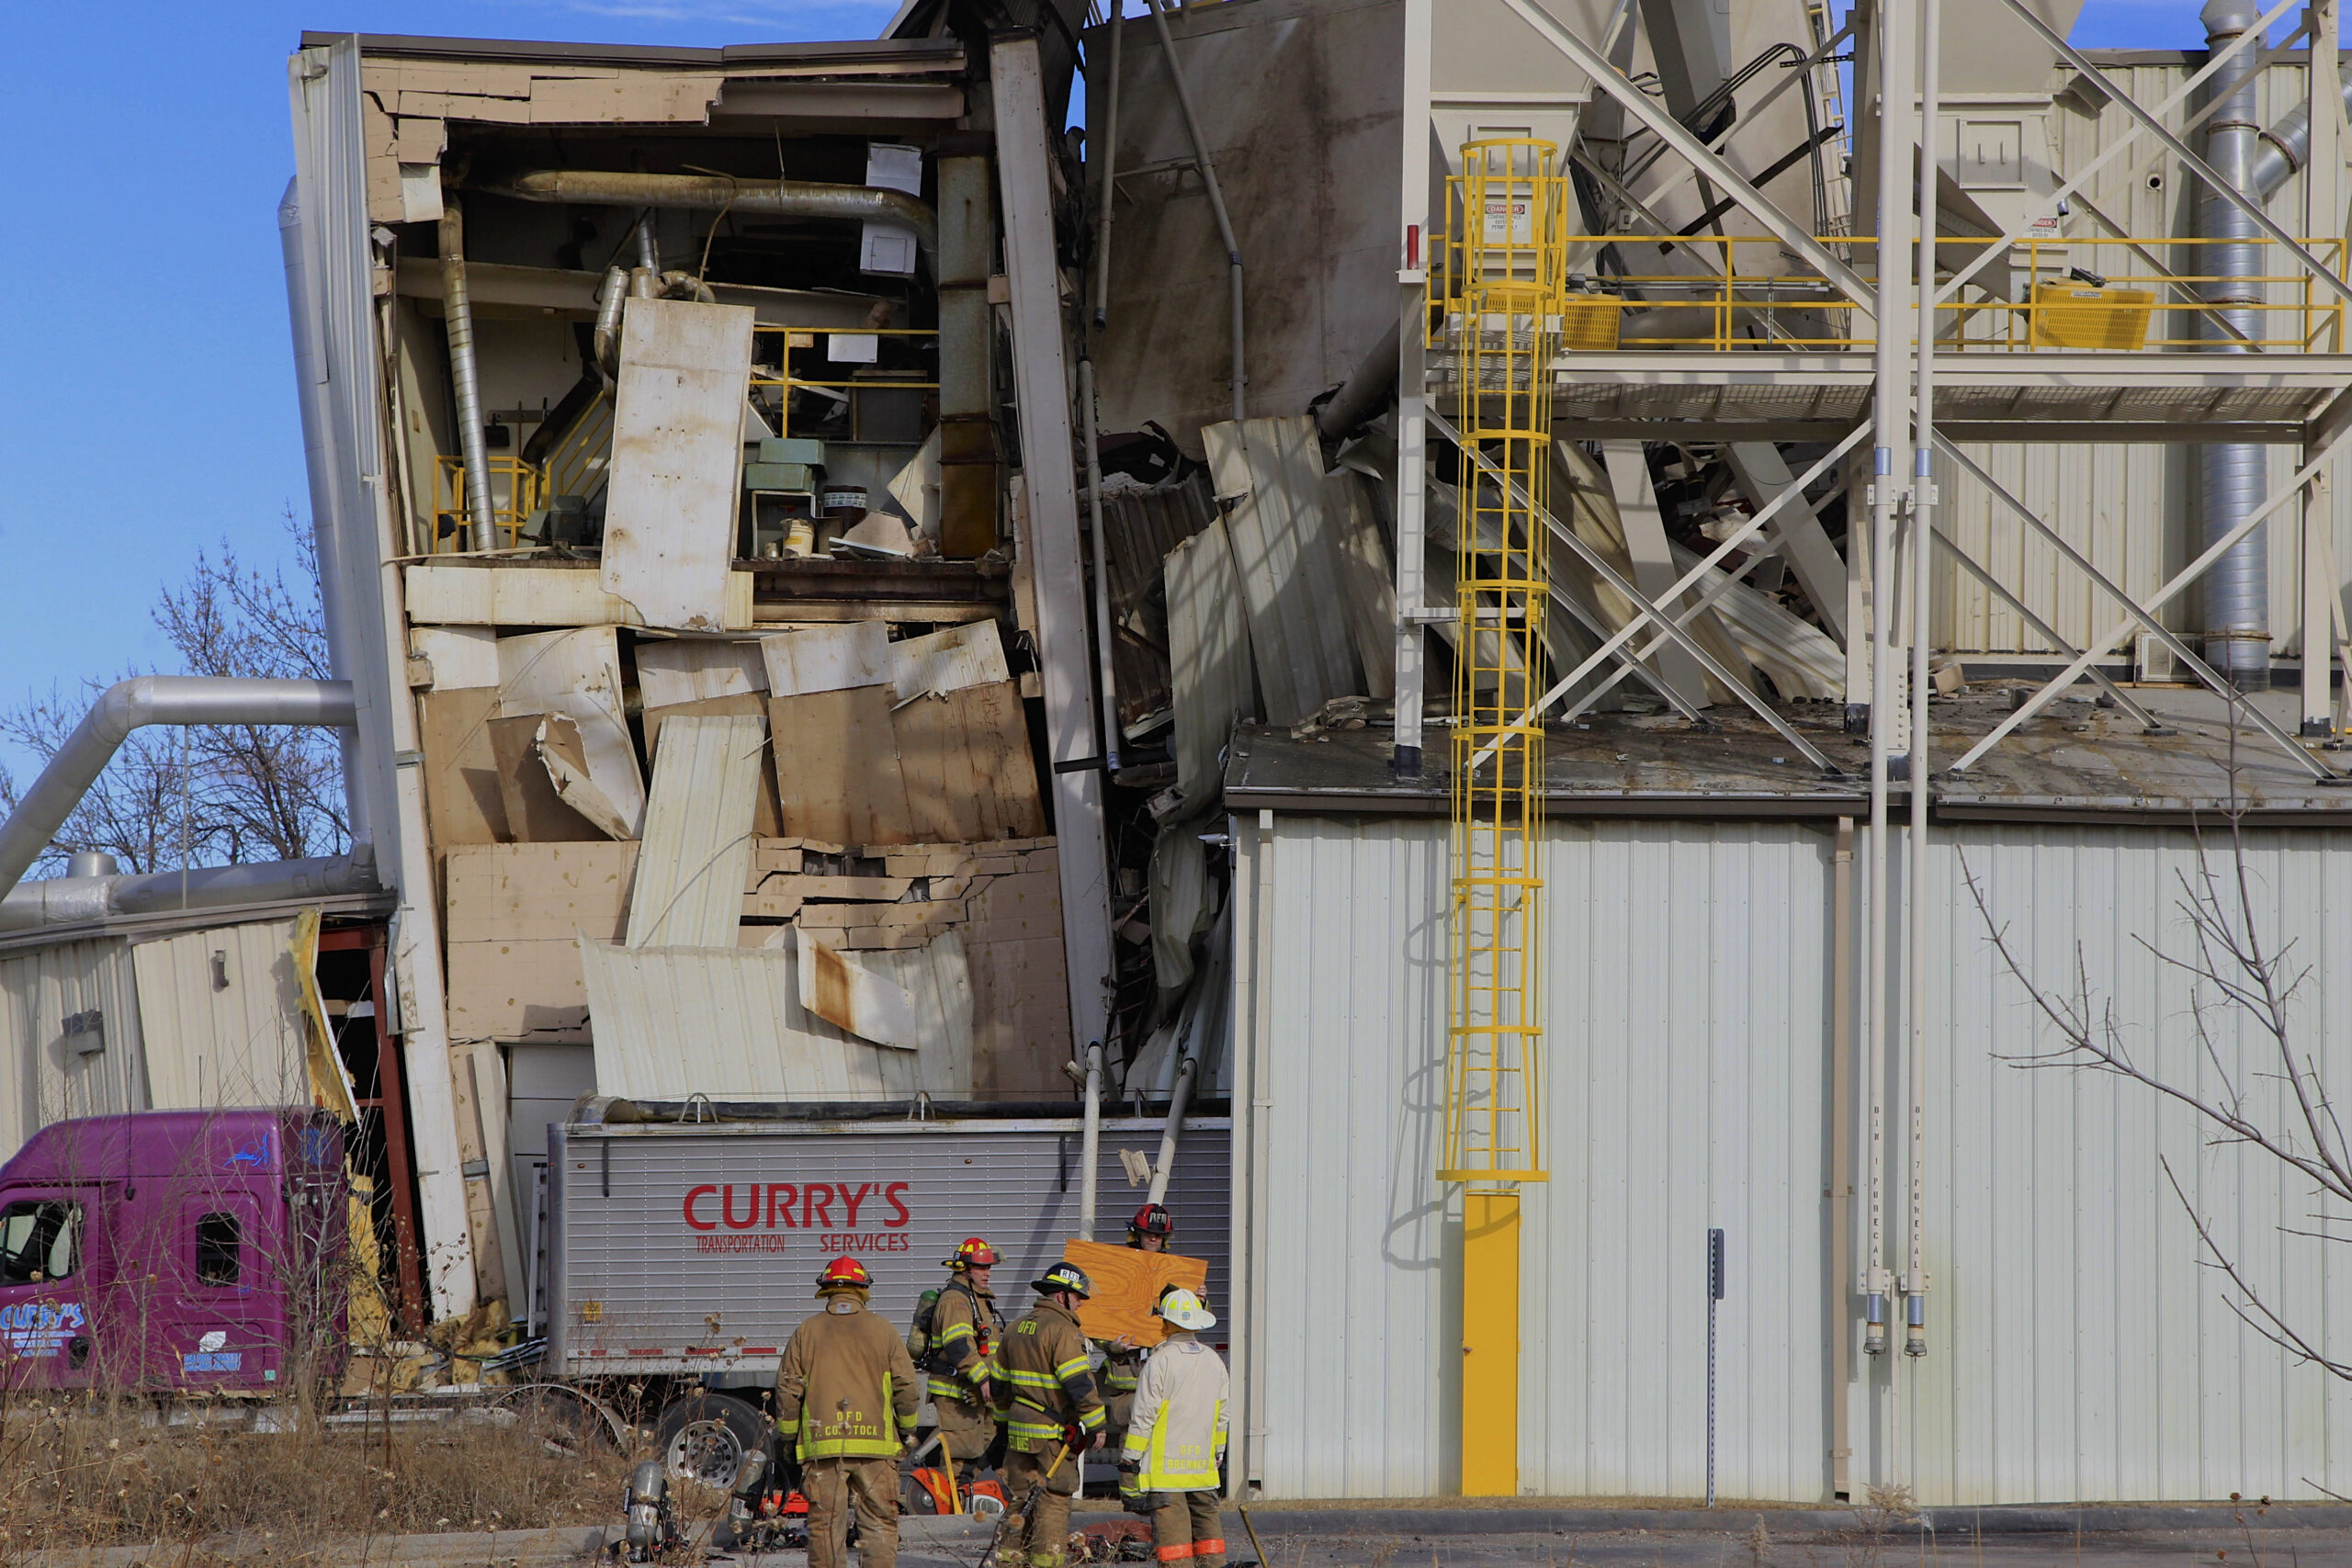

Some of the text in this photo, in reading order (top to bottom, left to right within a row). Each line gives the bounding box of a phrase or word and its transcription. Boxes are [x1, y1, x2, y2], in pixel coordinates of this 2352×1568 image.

[683, 1181, 910, 1231] CURRY'S
[695, 1233, 910, 1254] TRANSPORTATION SERVICES
[1071, 1271, 1080, 1281] 33
[1017, 1320, 1037, 1336] OFD
